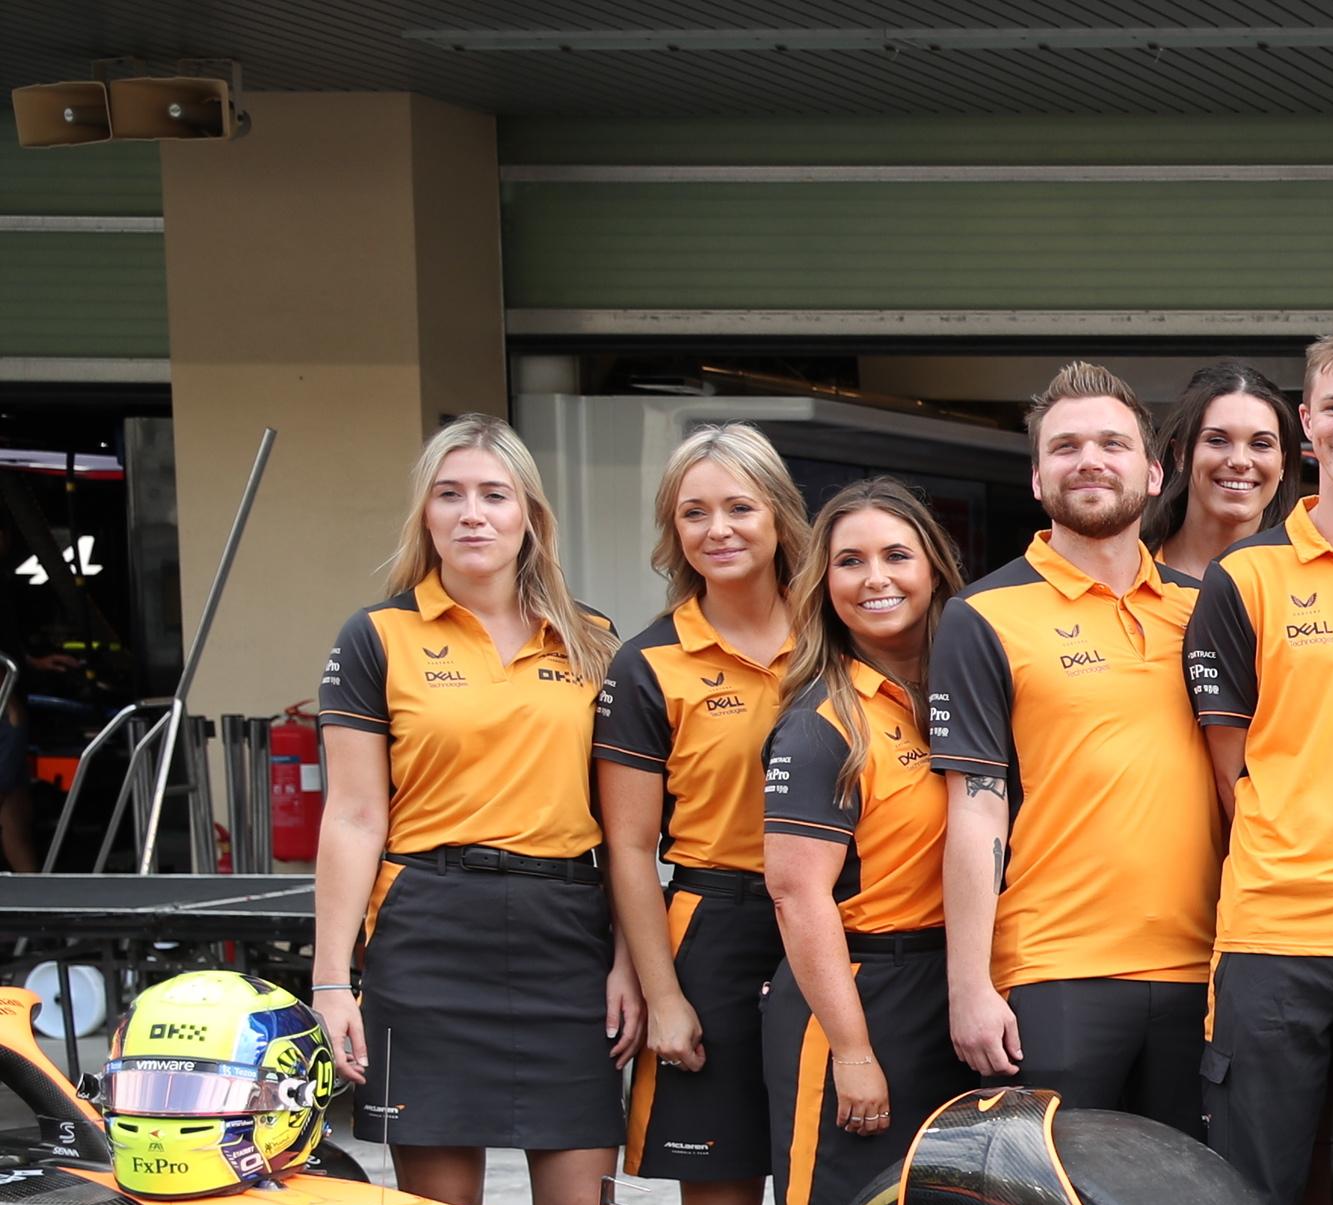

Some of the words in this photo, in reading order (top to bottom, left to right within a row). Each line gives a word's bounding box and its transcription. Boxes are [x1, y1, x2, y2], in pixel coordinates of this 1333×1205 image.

[1286, 620, 1333, 639] DELL
[1060, 650, 1105, 670] DELL
[424, 671, 466, 681] DELL
[707, 696, 744, 711] DELL
[930, 707, 951, 721] Pro
[898, 748, 928, 767] DELL
[150, 1023, 207, 1042] OKX
[136, 1060, 196, 1071] vmware
[664, 1141, 710, 1150] McLaren
[132, 1157, 189, 1174] FxPro
